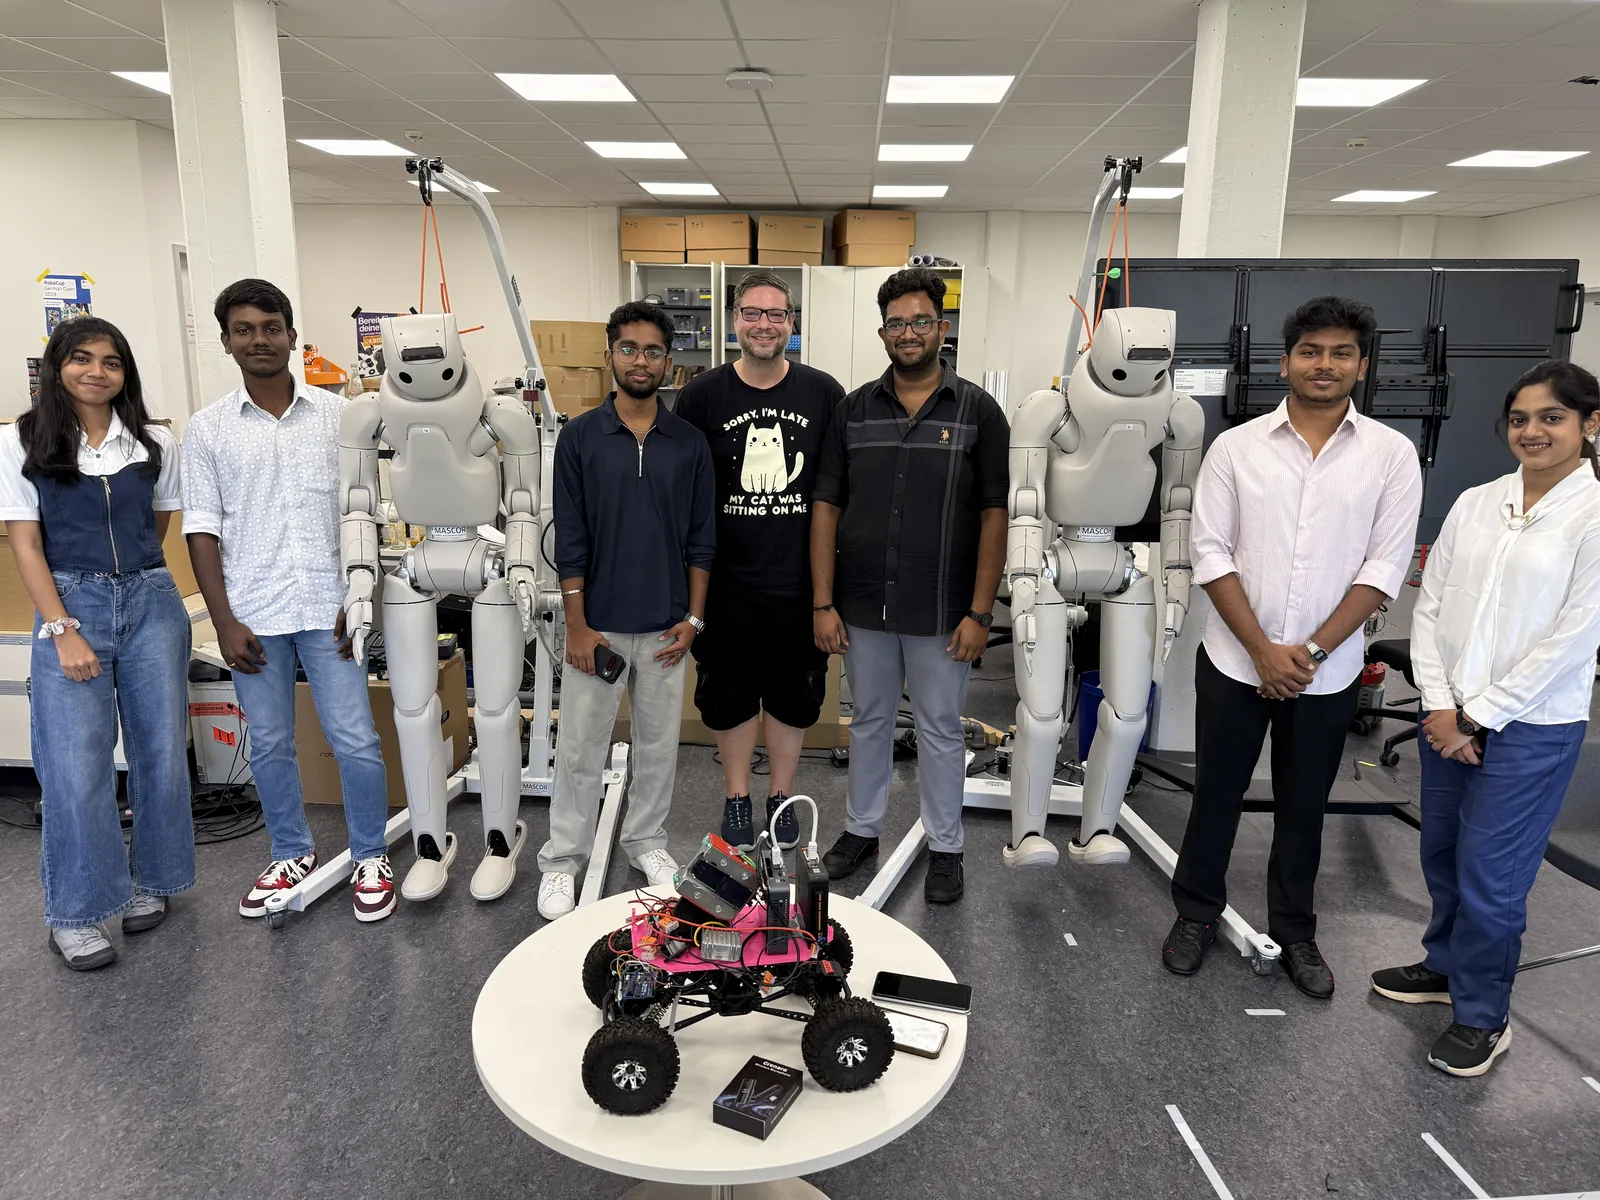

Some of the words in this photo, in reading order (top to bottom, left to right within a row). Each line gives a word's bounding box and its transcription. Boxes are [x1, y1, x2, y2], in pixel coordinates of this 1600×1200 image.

[360, 324, 380, 332] deine
[723, 409, 759, 431] SORRY,
[761, 407, 778, 417] I'M
[780, 409, 809, 428] LATE
[729, 494, 745, 505] MY
[750, 495, 774, 505] CAT
[778, 493, 802, 504] WAS
[723, 504, 767, 516] SITTING
[771, 505, 789, 515] ON
[792, 503, 807, 514] ME
